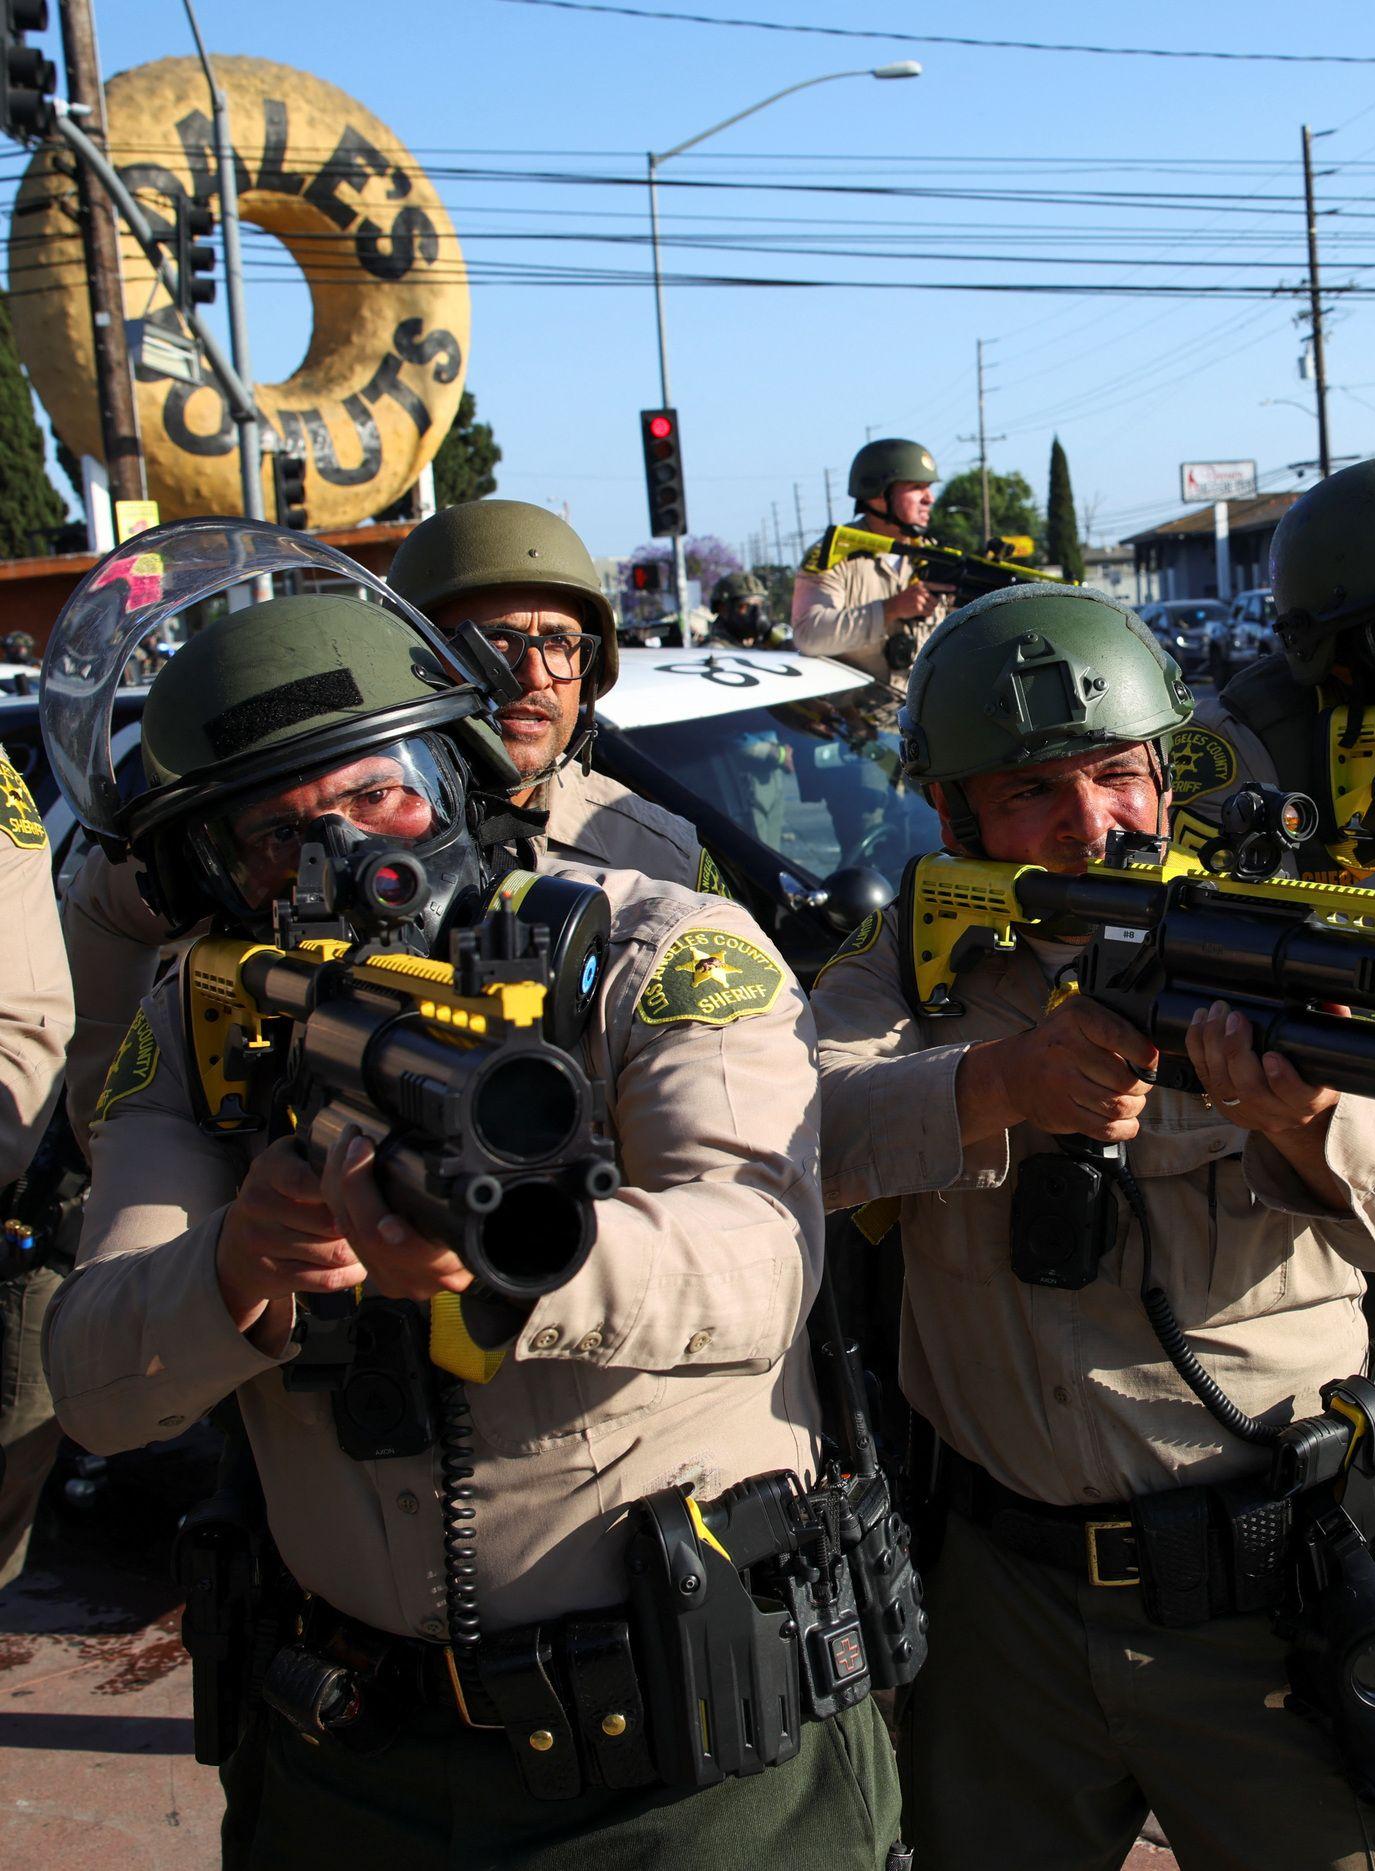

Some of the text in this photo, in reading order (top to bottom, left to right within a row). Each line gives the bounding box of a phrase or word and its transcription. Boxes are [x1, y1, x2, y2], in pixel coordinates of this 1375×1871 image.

[1206, 741, 1228, 780] COUNTY
[1171, 780, 1202, 793] ERIFF
[9, 817, 45, 838] SHERIFF
[1123, 930, 1135, 939] #8
[644, 933, 781, 1015] LOS ANGELES COUNTY
[697, 983, 767, 1014] SHERIFF
